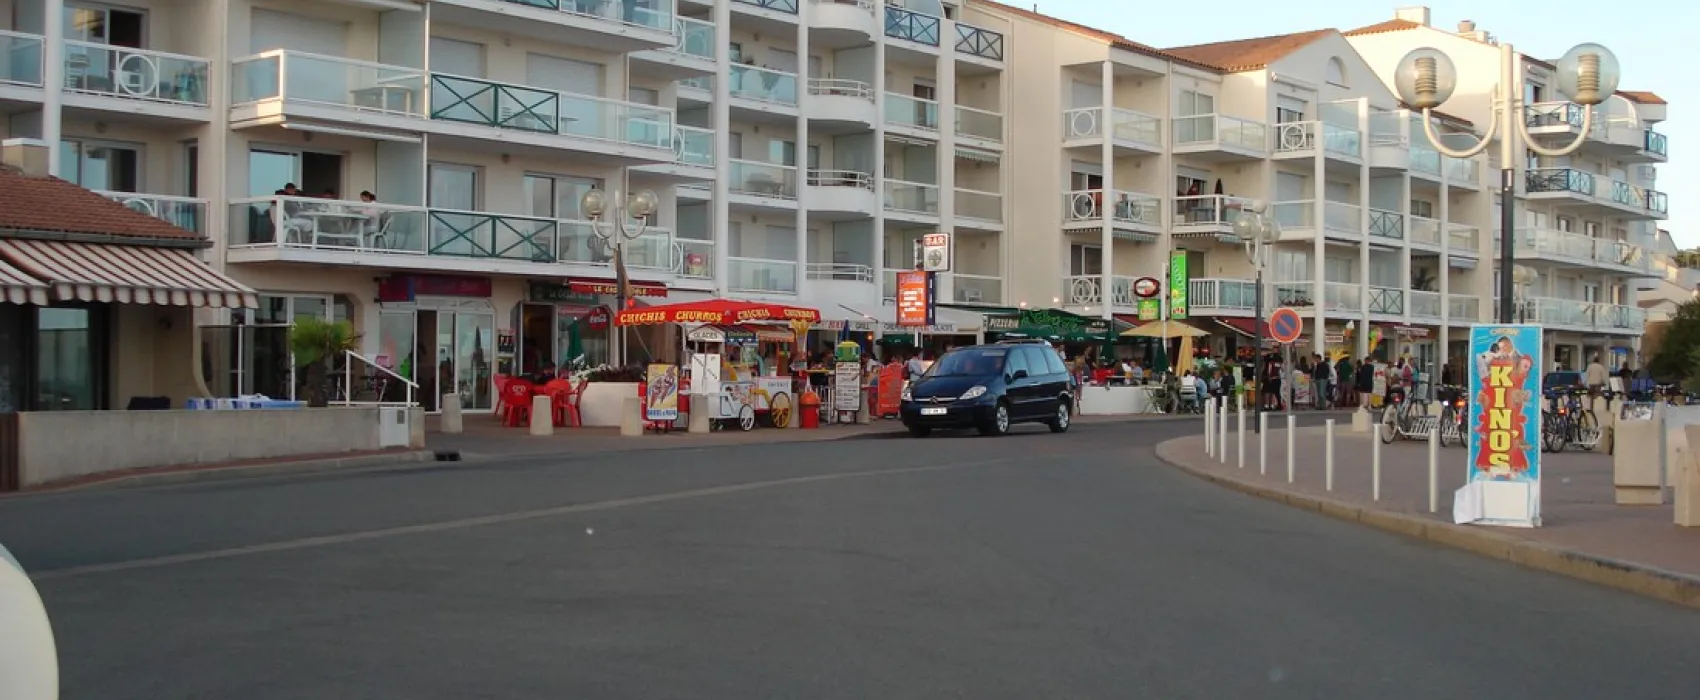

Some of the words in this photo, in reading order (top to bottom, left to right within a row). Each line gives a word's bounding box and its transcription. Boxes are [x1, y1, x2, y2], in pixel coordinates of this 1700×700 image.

[924, 236, 945, 247] BAR
[620, 311, 666, 323] CHICHIS
[675, 310, 723, 322] CHURROS
[737, 308, 770, 320] CHICHIS
[692, 331, 718, 340] GLACES
